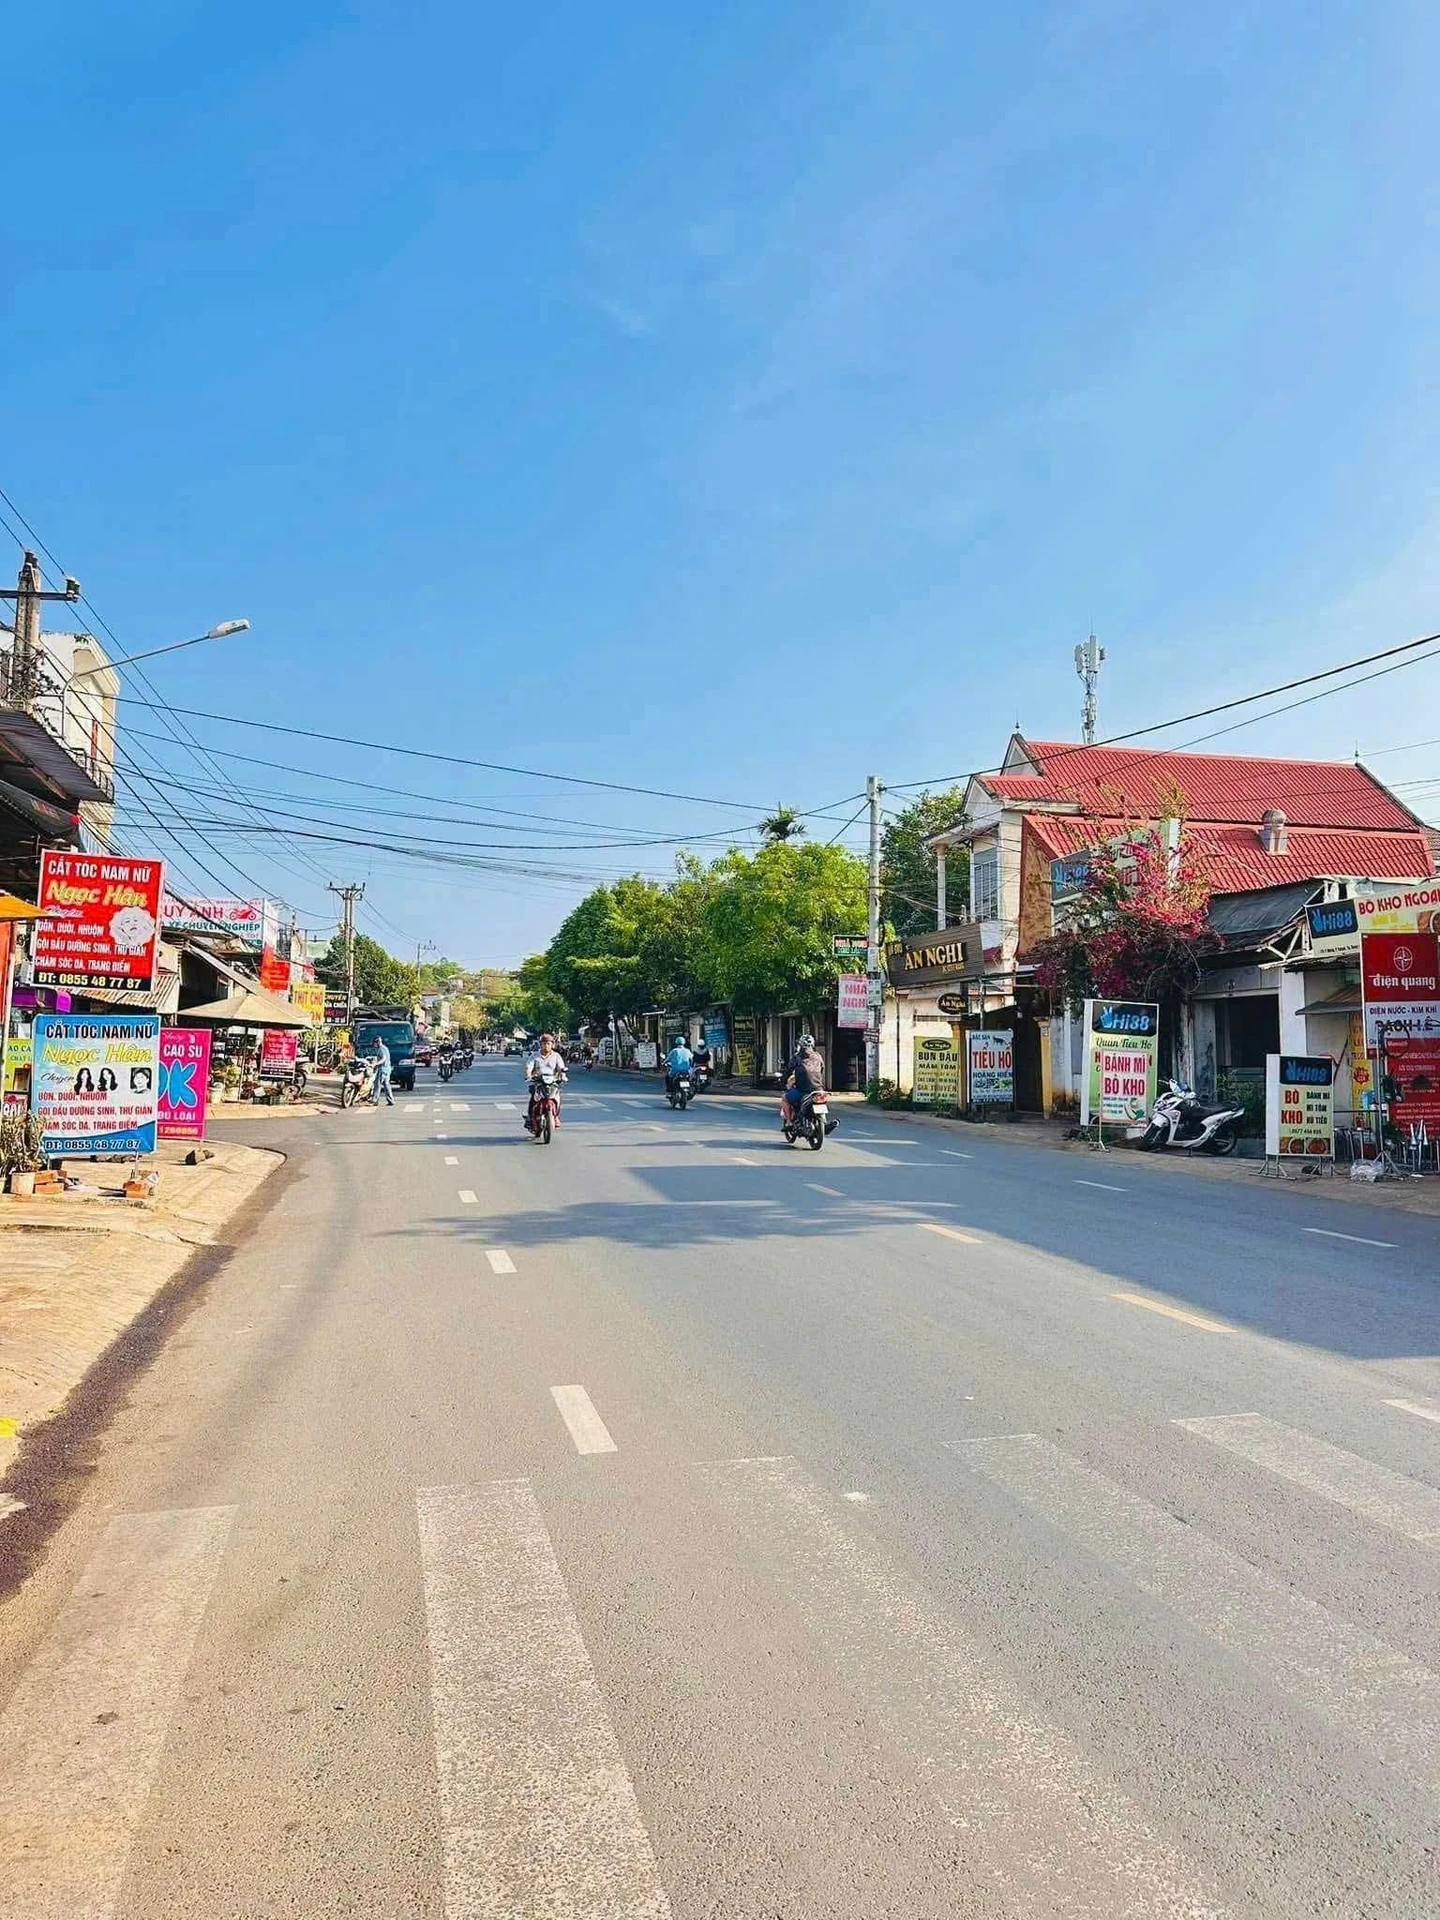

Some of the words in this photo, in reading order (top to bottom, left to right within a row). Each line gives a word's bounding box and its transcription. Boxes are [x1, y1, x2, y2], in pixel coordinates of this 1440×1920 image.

[101, 865, 129, 881] NAM
[1377, 897, 1402, 913] KHO
[39, 972, 56, 984] ĐT:
[59, 973, 88, 986] 0855
[91, 975, 106, 987] 48
[109, 976, 123, 987] 77
[126, 977, 141, 989] 87
[1401, 976, 1436, 990] quang
[1113, 1013, 1150, 1031] Hi88
[102, 1024, 131, 1038] NAM
[163, 1044, 185, 1058] CAO
[188, 1045, 203, 1058] SU
[1122, 1077, 1146, 1097] KHO
[1284, 1088, 1300, 1105] BÒ
[1281, 1109, 1303, 1125] KHO
[93, 1121, 117, 1131] TRANG
[64, 1140, 91, 1150] 0855
[93, 1140, 108, 1150] 48
[110, 1140, 123, 1150] 77
[126, 1139, 141, 1149] 87
